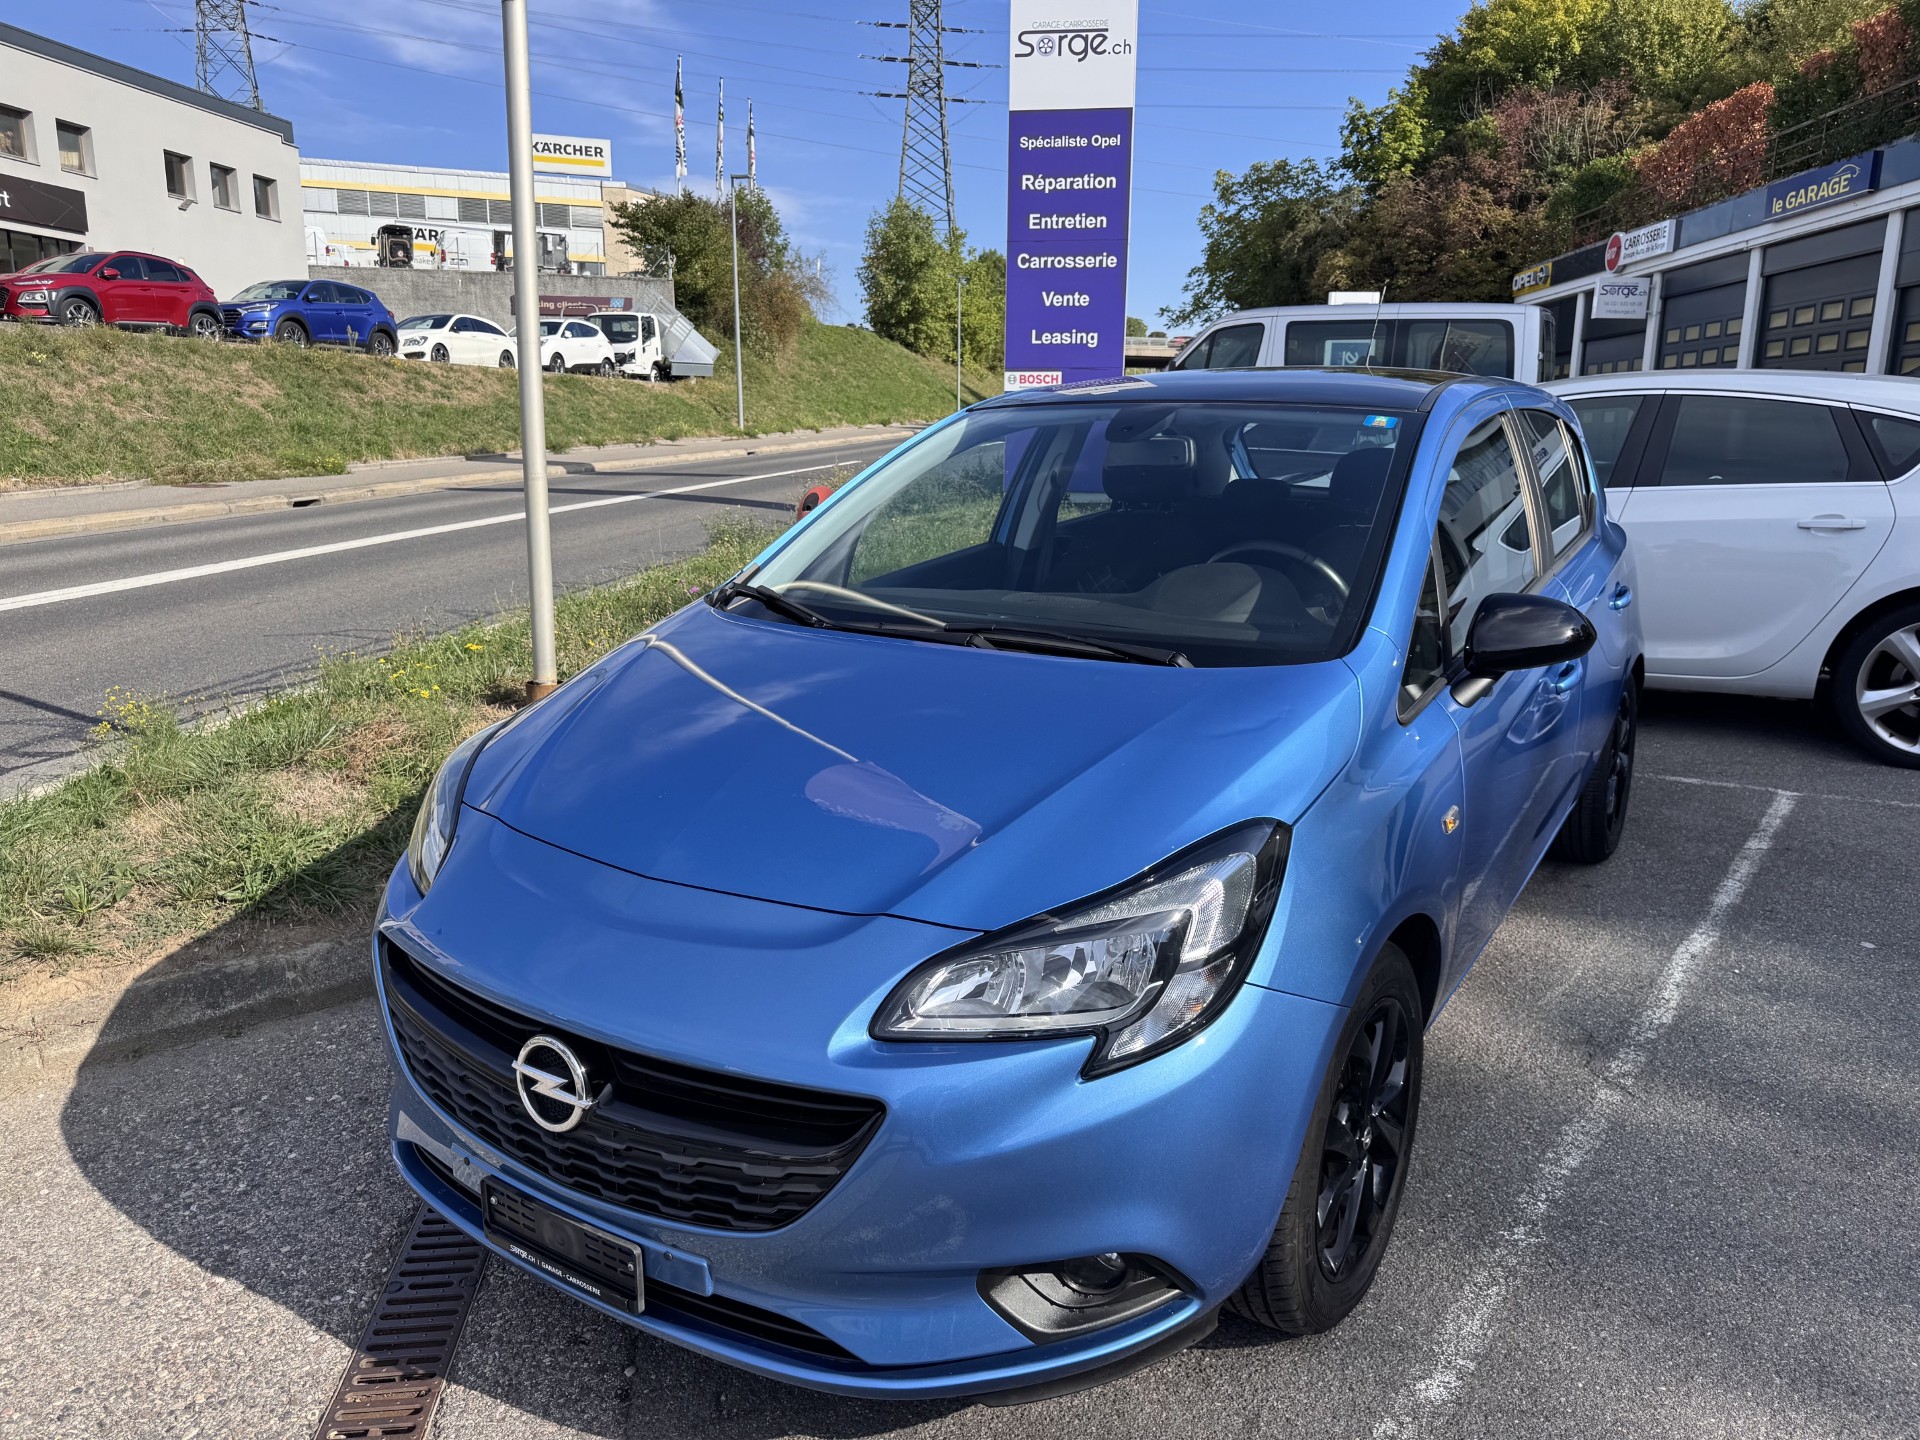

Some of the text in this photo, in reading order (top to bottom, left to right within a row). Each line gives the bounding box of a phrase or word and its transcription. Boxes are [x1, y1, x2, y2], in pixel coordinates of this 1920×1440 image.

[1032, 20, 1109, 29] GARAGE-CARROSSERIE
[1015, 28, 1131, 62] Sorge.ch
[1020, 135, 1121, 150] Spécialiste Opel
[1021, 174, 1117, 193] Réparation
[1772, 174, 1851, 213] le GARAGE
[1029, 213, 1107, 230] Entretien
[1623, 225, 1668, 250] CARROSSERIE
[1017, 253, 1117, 269] Carrosserie
[1512, 273, 1537, 290] OPEL
[1042, 291, 1090, 307] Vente
[1600, 284, 1648, 299] Sorge.ch
[1031, 329, 1098, 347] Leasing
[1019, 374, 1059, 384] BOSCH
[541, 1261, 563, 1277] GARAGE
[566, 1274, 601, 1296] CARROSSERIE
